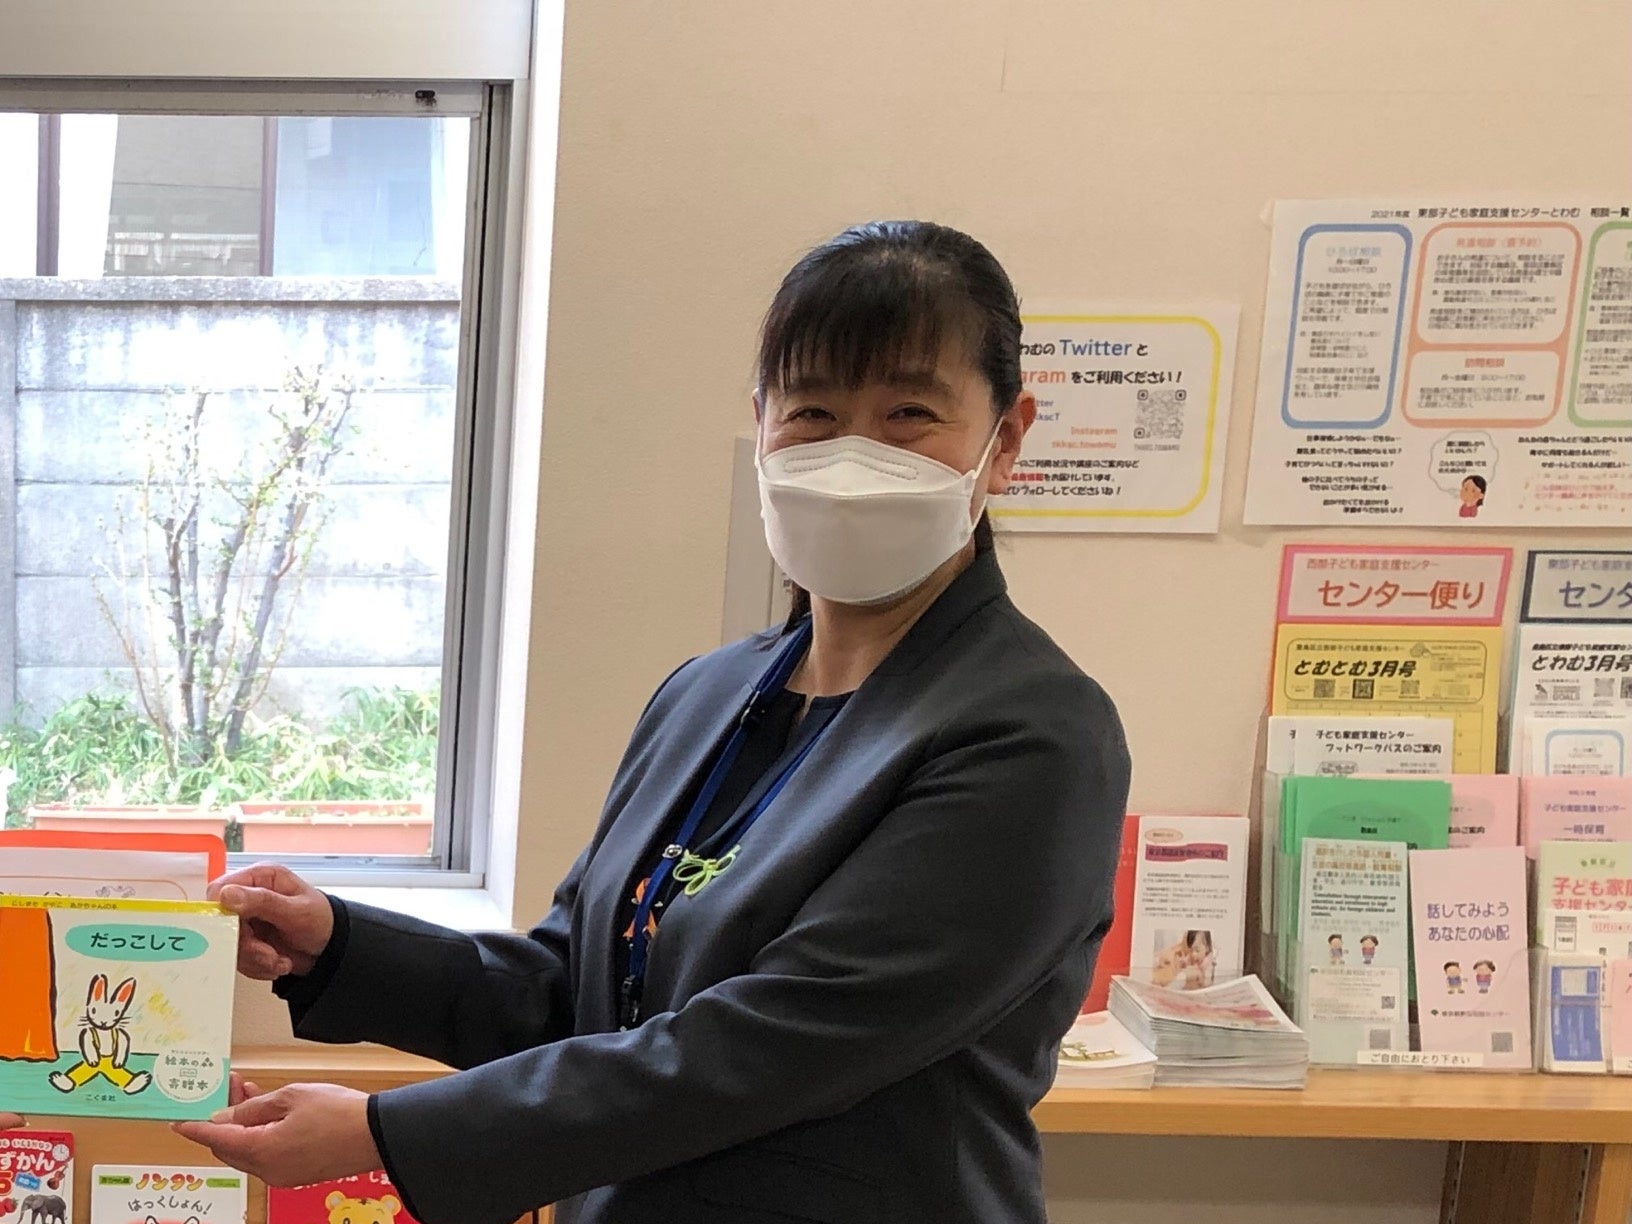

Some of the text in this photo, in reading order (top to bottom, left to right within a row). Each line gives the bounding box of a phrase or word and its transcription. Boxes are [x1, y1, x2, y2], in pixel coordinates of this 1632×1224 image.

[1059, 339, 1132, 356] Twitter
[1136, 344, 1149, 357] と
[1318, 580, 1485, 610] センター便り
[1294, 659, 1417, 678] とむとむ3月号
[1427, 902, 1510, 920] 話してみよう
[90, 931, 187, 952] だっこして
[1428, 924, 1510, 942] あなたの心配
[1370, 1053, 1471, 1065] ご自由におとり下さい
[135, 1172, 204, 1192] ノンタン
[128, 1194, 213, 1216] はっくしょん!
